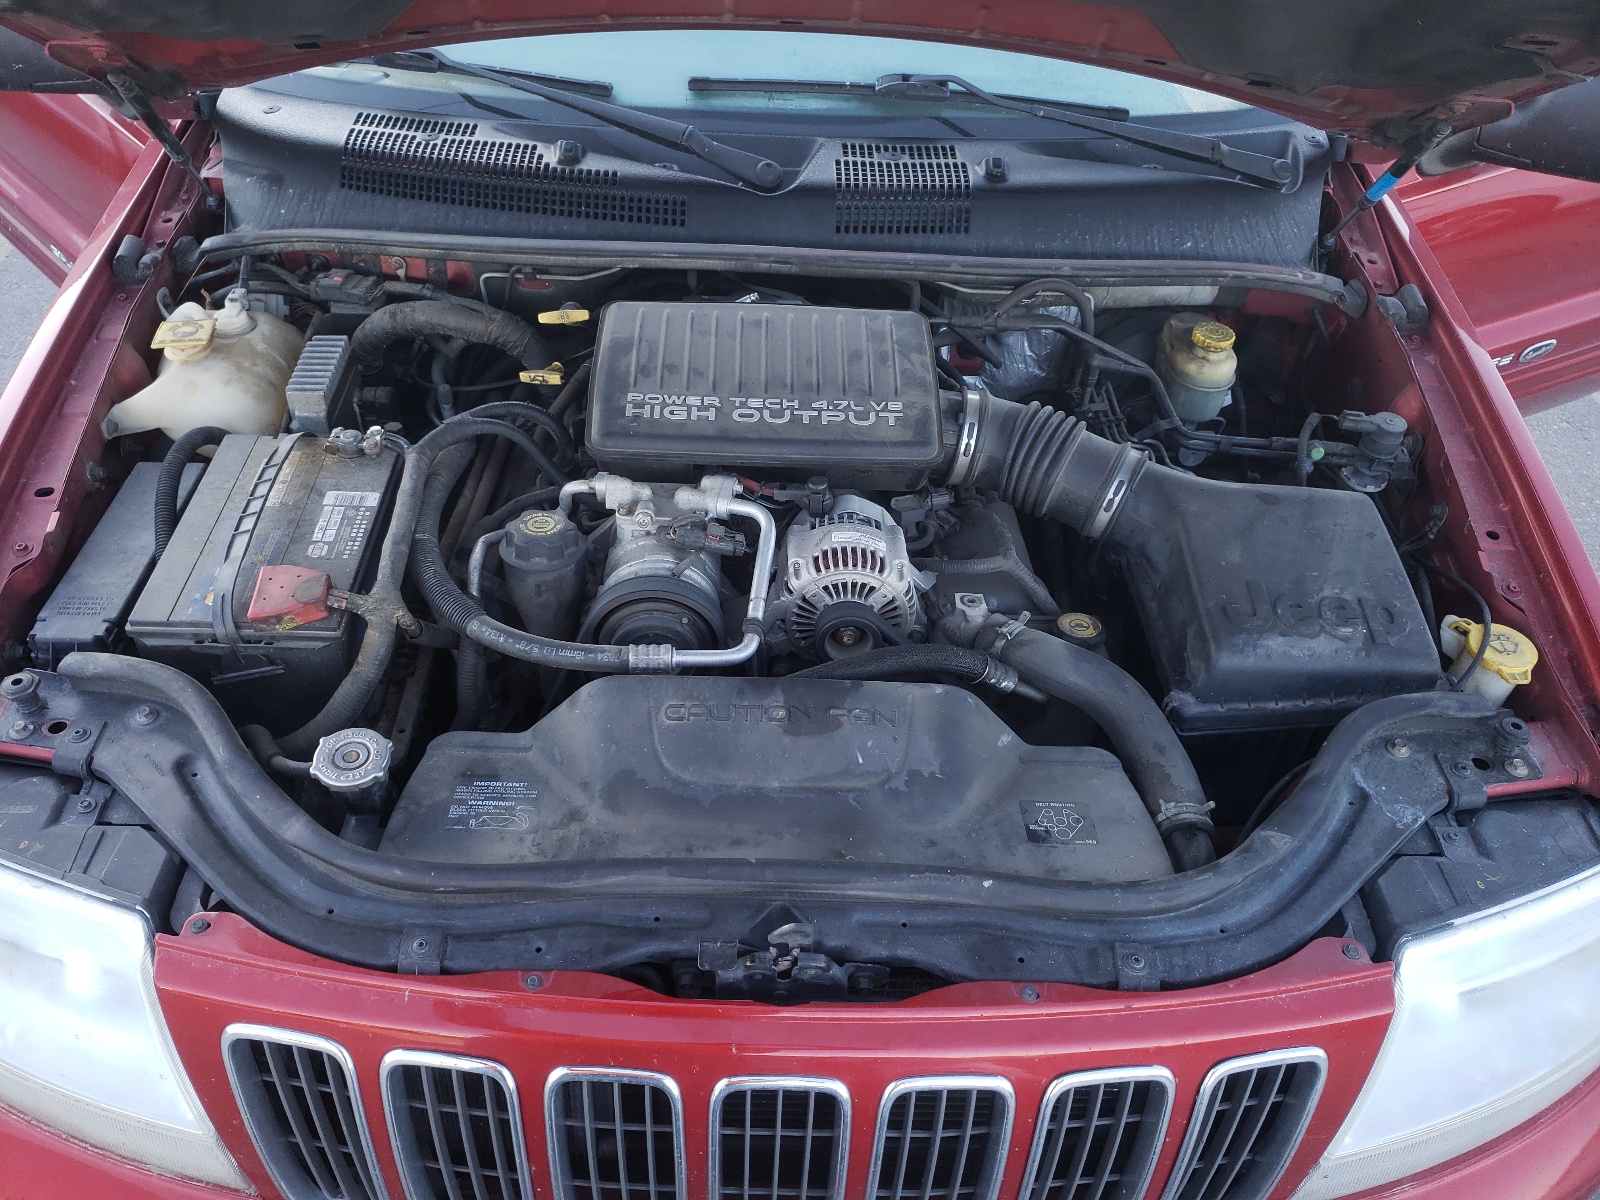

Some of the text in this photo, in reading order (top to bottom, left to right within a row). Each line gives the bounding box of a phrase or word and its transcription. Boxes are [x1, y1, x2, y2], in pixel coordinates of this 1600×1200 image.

[627, 392, 903, 411] POWER TECH 4.7L V8
[625, 403, 904, 426] HIGH OUTPUT
[1222, 581, 1409, 644] Jeep
[664, 703, 897, 727] CAUTION FAN
